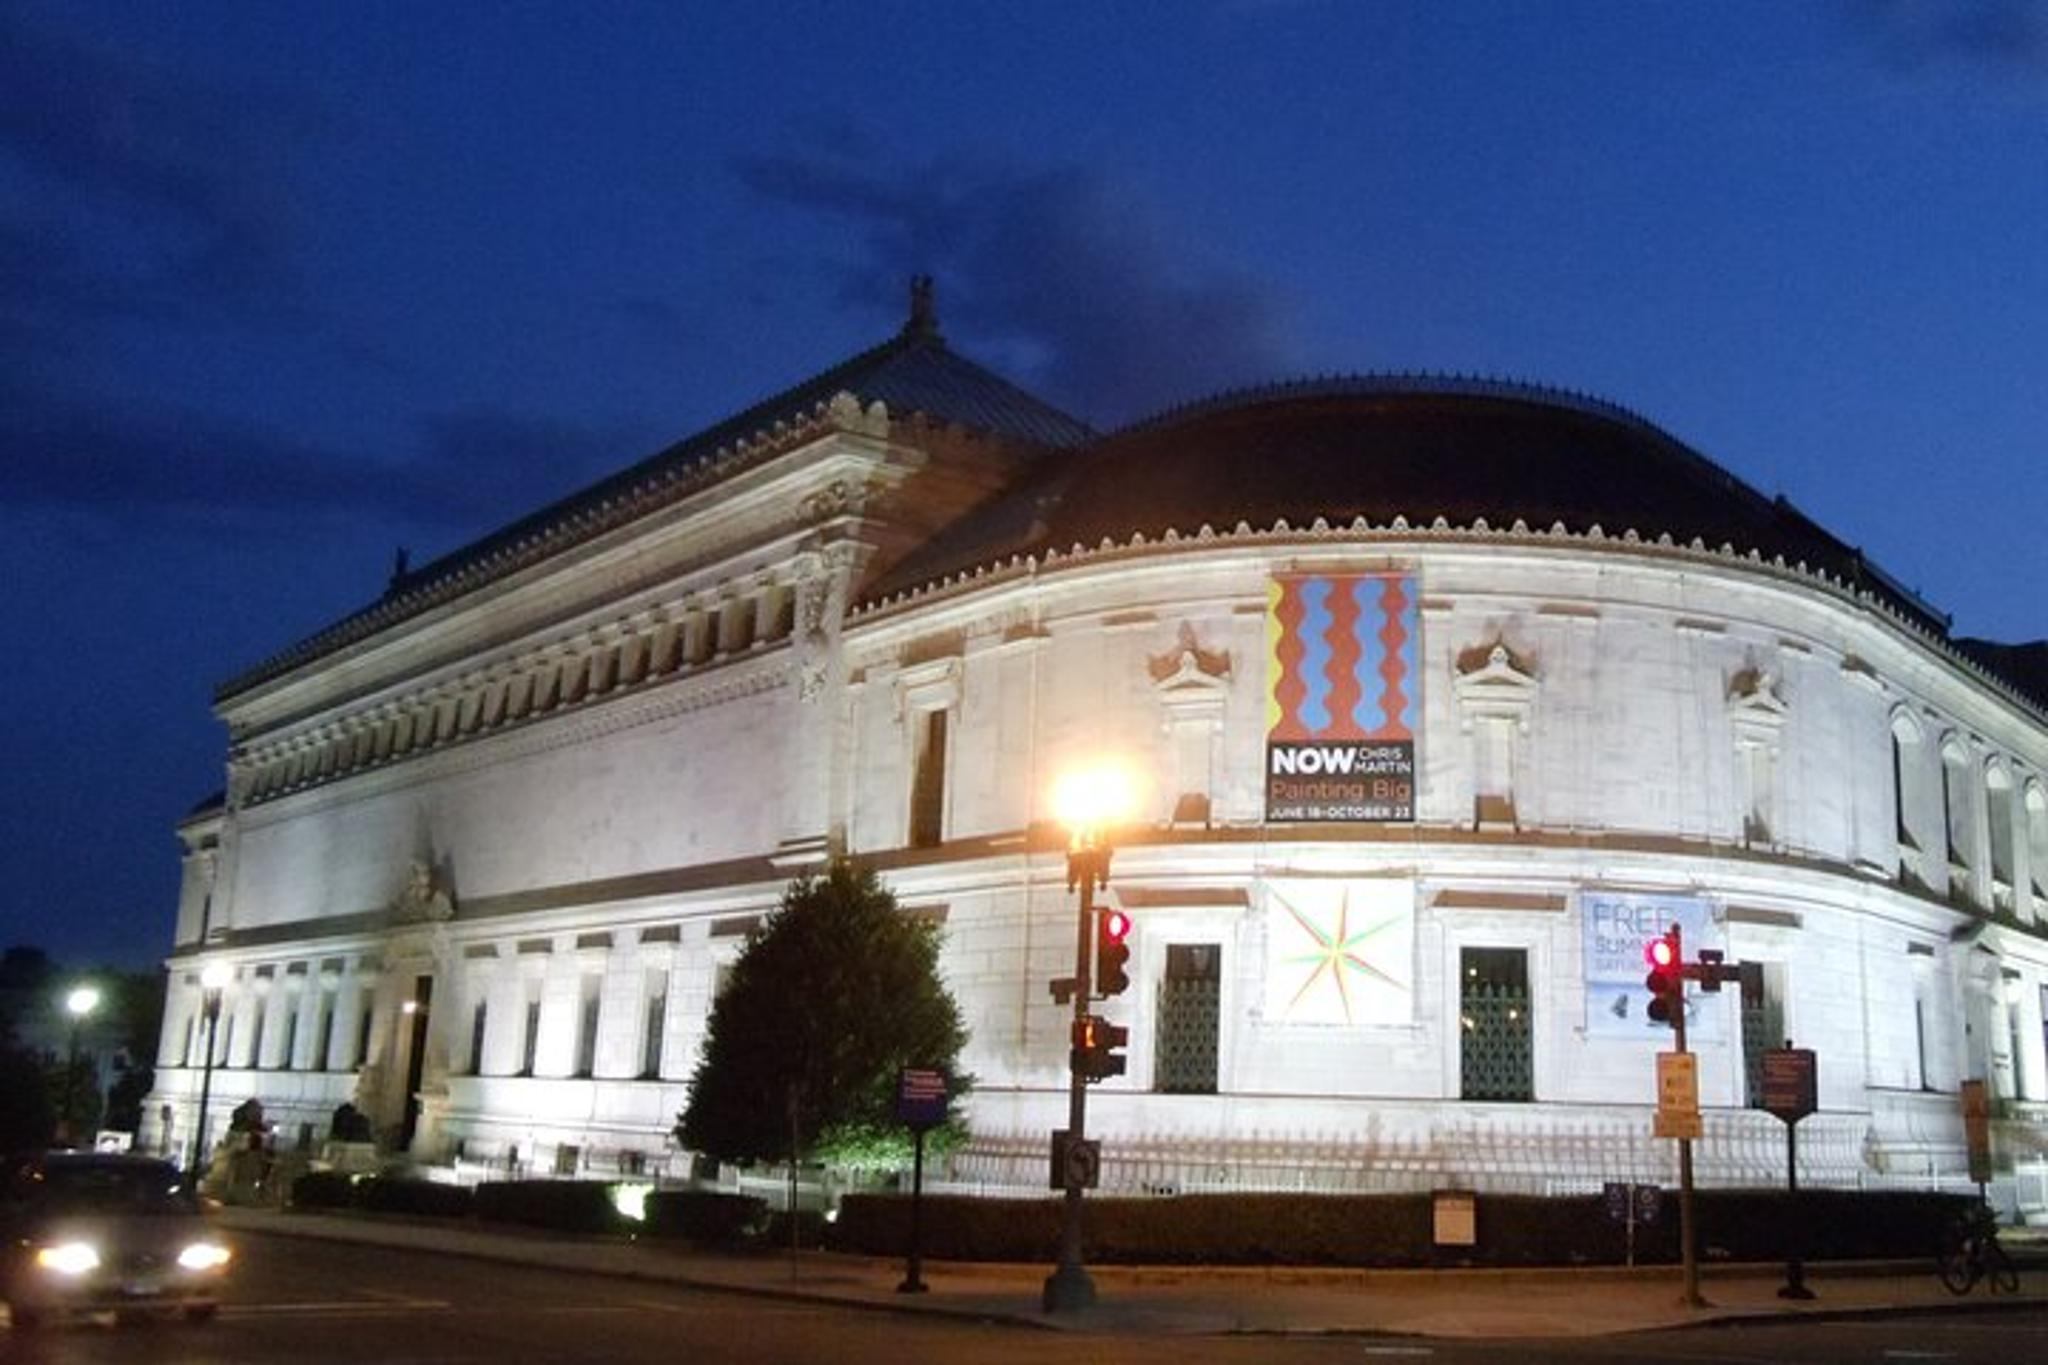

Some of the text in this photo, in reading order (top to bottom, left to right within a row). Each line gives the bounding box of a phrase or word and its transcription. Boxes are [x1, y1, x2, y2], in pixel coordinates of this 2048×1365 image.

[1272, 747, 1357, 774] NOW
[1359, 747, 1403, 760] CHRIS
[1353, 760, 1412, 774] MARTIN
[1270, 778, 1411, 802] Painting Big
[1269, 806, 1304, 819] JUNE
